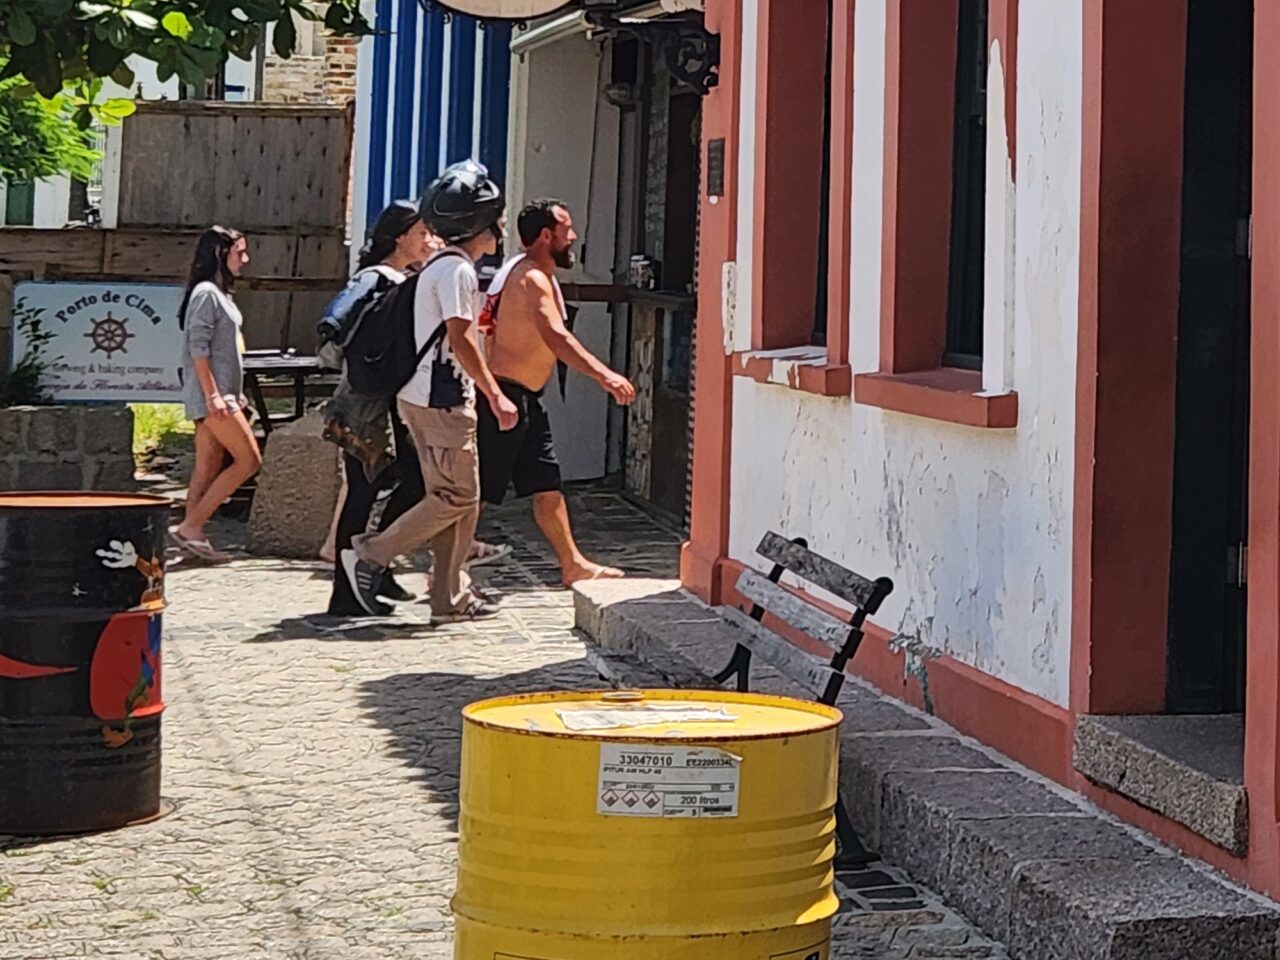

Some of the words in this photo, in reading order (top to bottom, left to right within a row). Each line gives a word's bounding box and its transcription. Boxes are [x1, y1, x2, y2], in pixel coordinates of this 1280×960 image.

[54, 295, 97, 324] Porto
[102, 290, 121, 303] de
[125, 294, 162, 325] Cima
[620, 754, 673, 766] 33047010
[680, 796, 697, 805] 200
[699, 796, 719, 805] litros
